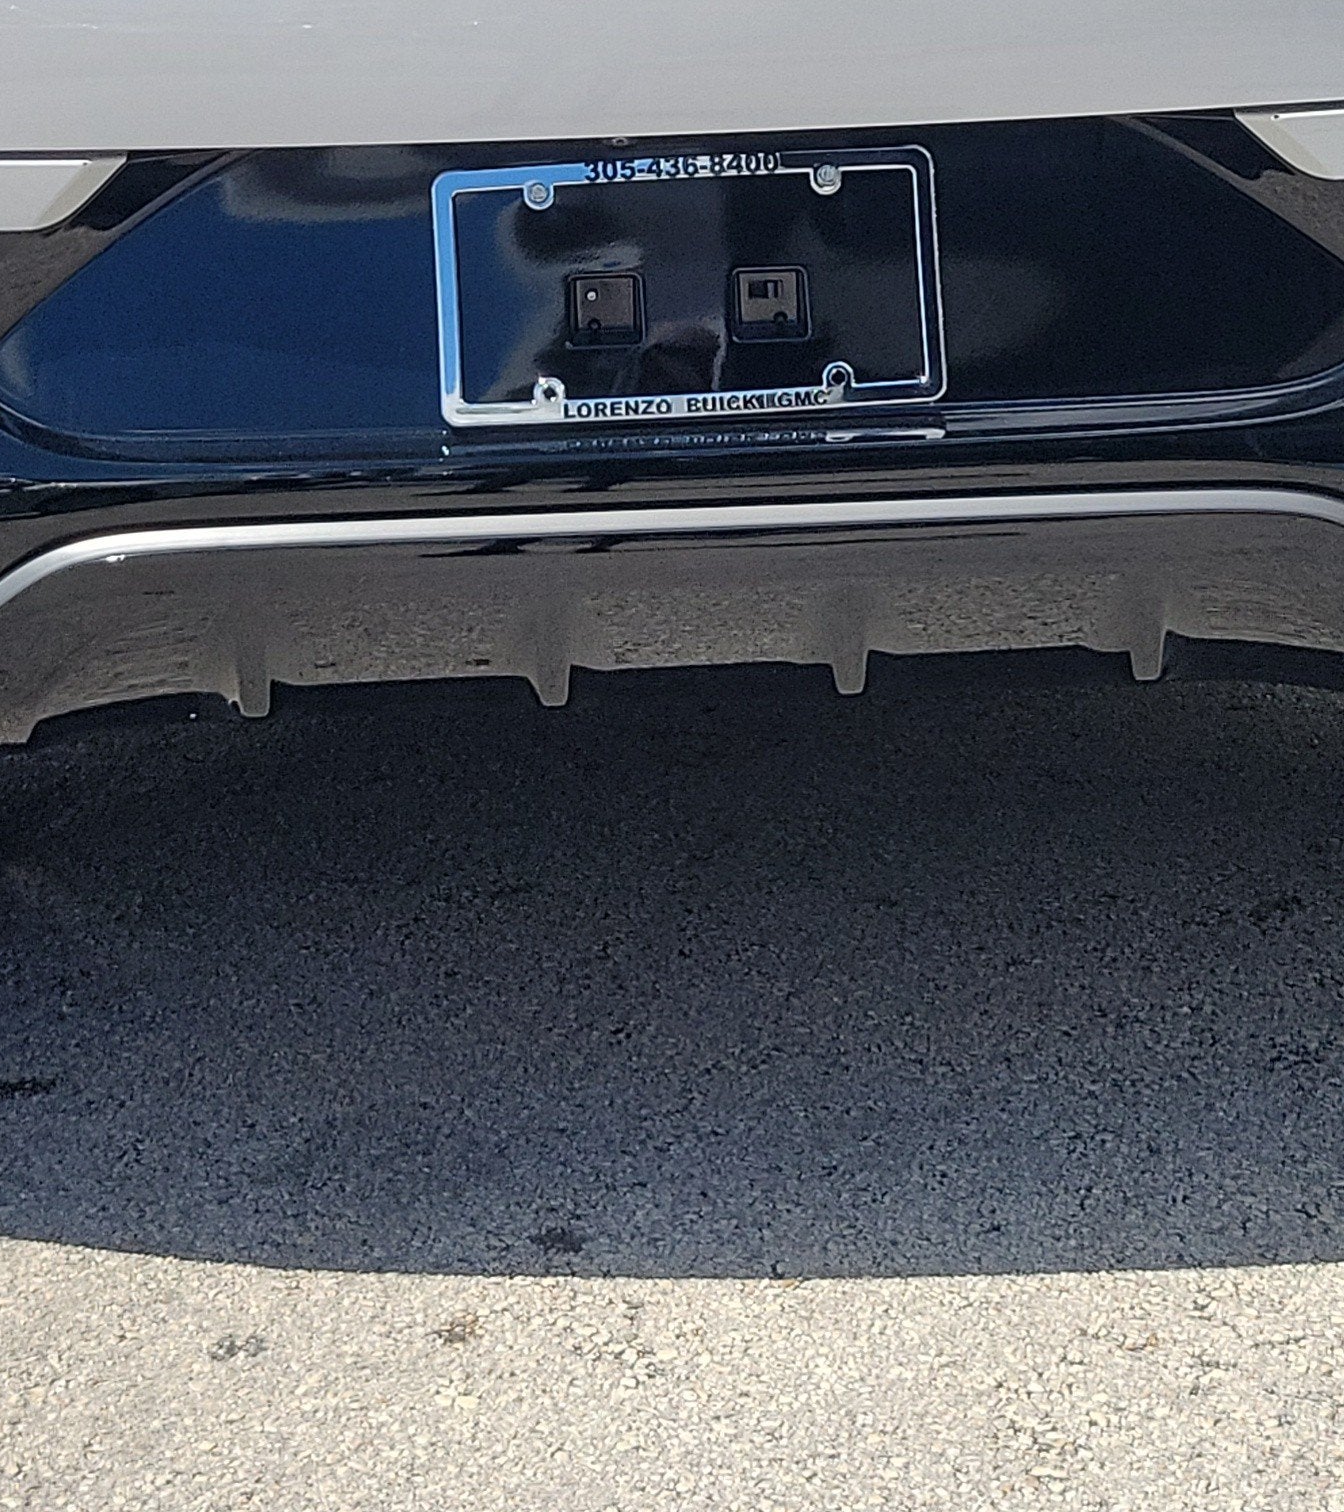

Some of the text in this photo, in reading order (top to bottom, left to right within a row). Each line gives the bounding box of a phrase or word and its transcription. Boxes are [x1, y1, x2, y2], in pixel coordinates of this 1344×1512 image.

[584, 152, 779, 182] 305-436-8400
[563, 399, 673, 419] LORENZO
[777, 390, 831, 408] GMC
